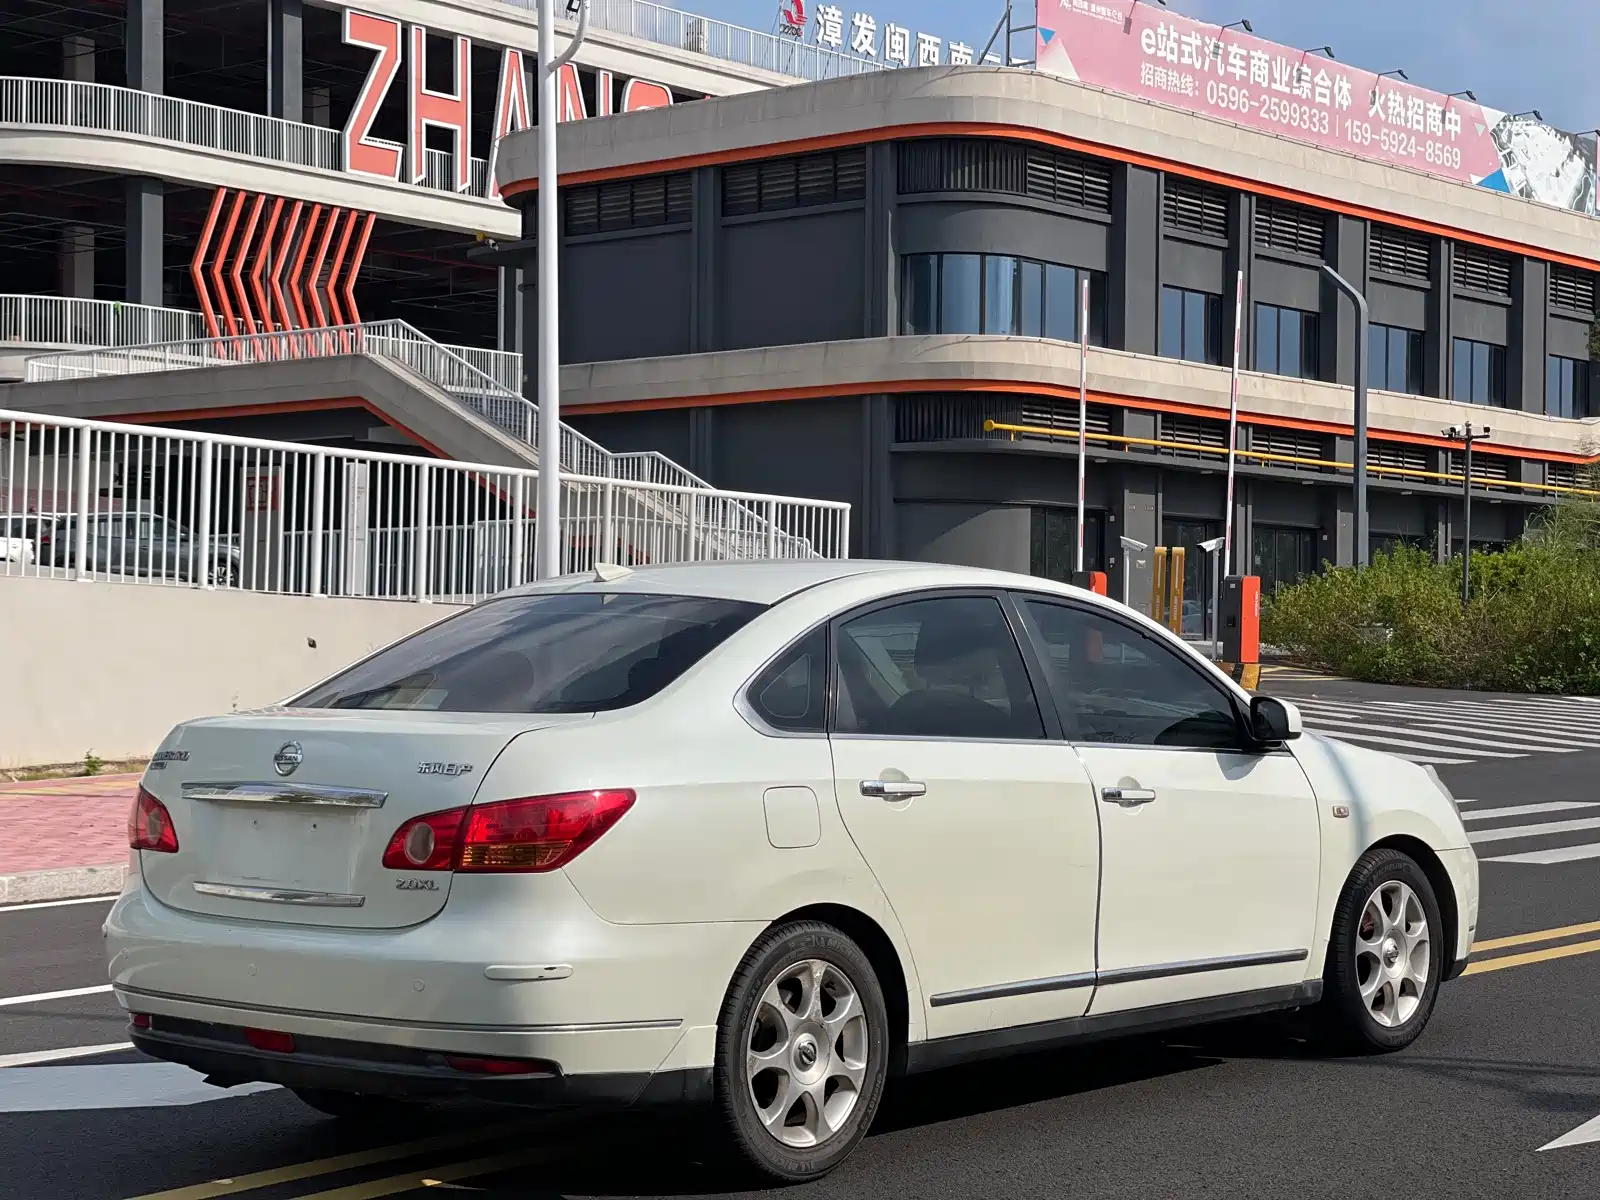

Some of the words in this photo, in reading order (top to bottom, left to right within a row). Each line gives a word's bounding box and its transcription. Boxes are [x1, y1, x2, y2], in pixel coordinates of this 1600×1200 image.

[815, 4, 1029, 67] 漳发闽西南
[342, 8, 674, 199] ZHA
[1140, 21, 1352, 111] e站式汽车商业综合体
[1368, 85, 1461, 142] 火热招商中
[1206, 80, 1329, 135] 0596-2599333
[1344, 118, 1461, 170] 159-5924-8569
[417, 761, 473, 776] 东风日产
[396, 878, 440, 891] 2.0XL
